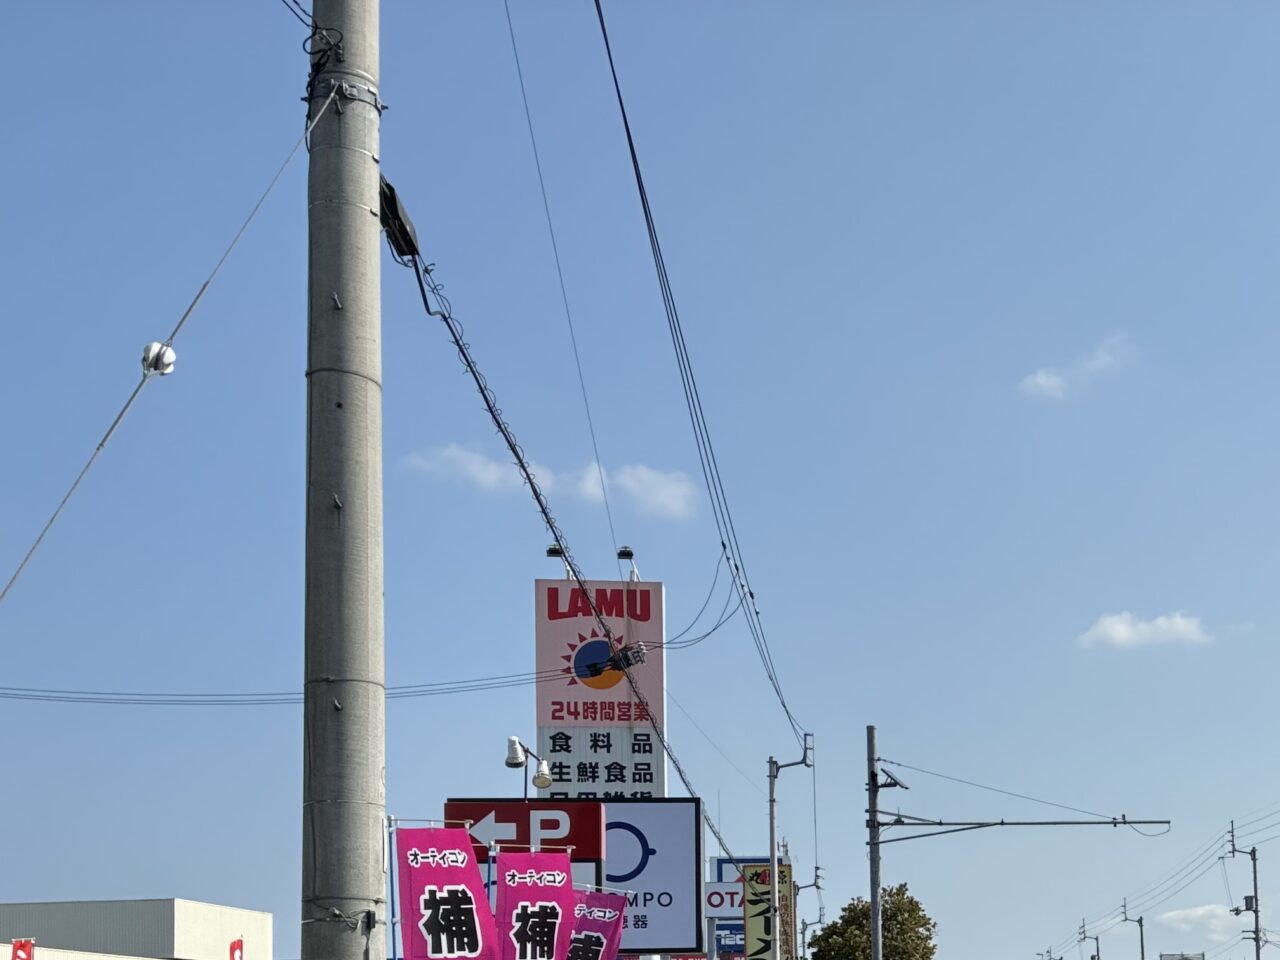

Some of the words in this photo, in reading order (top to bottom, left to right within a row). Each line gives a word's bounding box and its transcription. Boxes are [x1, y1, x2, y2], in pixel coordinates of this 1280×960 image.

[547, 587, 651, 622] LAMU
[551, 701, 650, 722] 24時間営業
[550, 761, 654, 783] 生鮮食品
[529, 809, 571, 853] P
[408, 849, 467, 866] オーティコン
[506, 871, 566, 886] オーティコン
